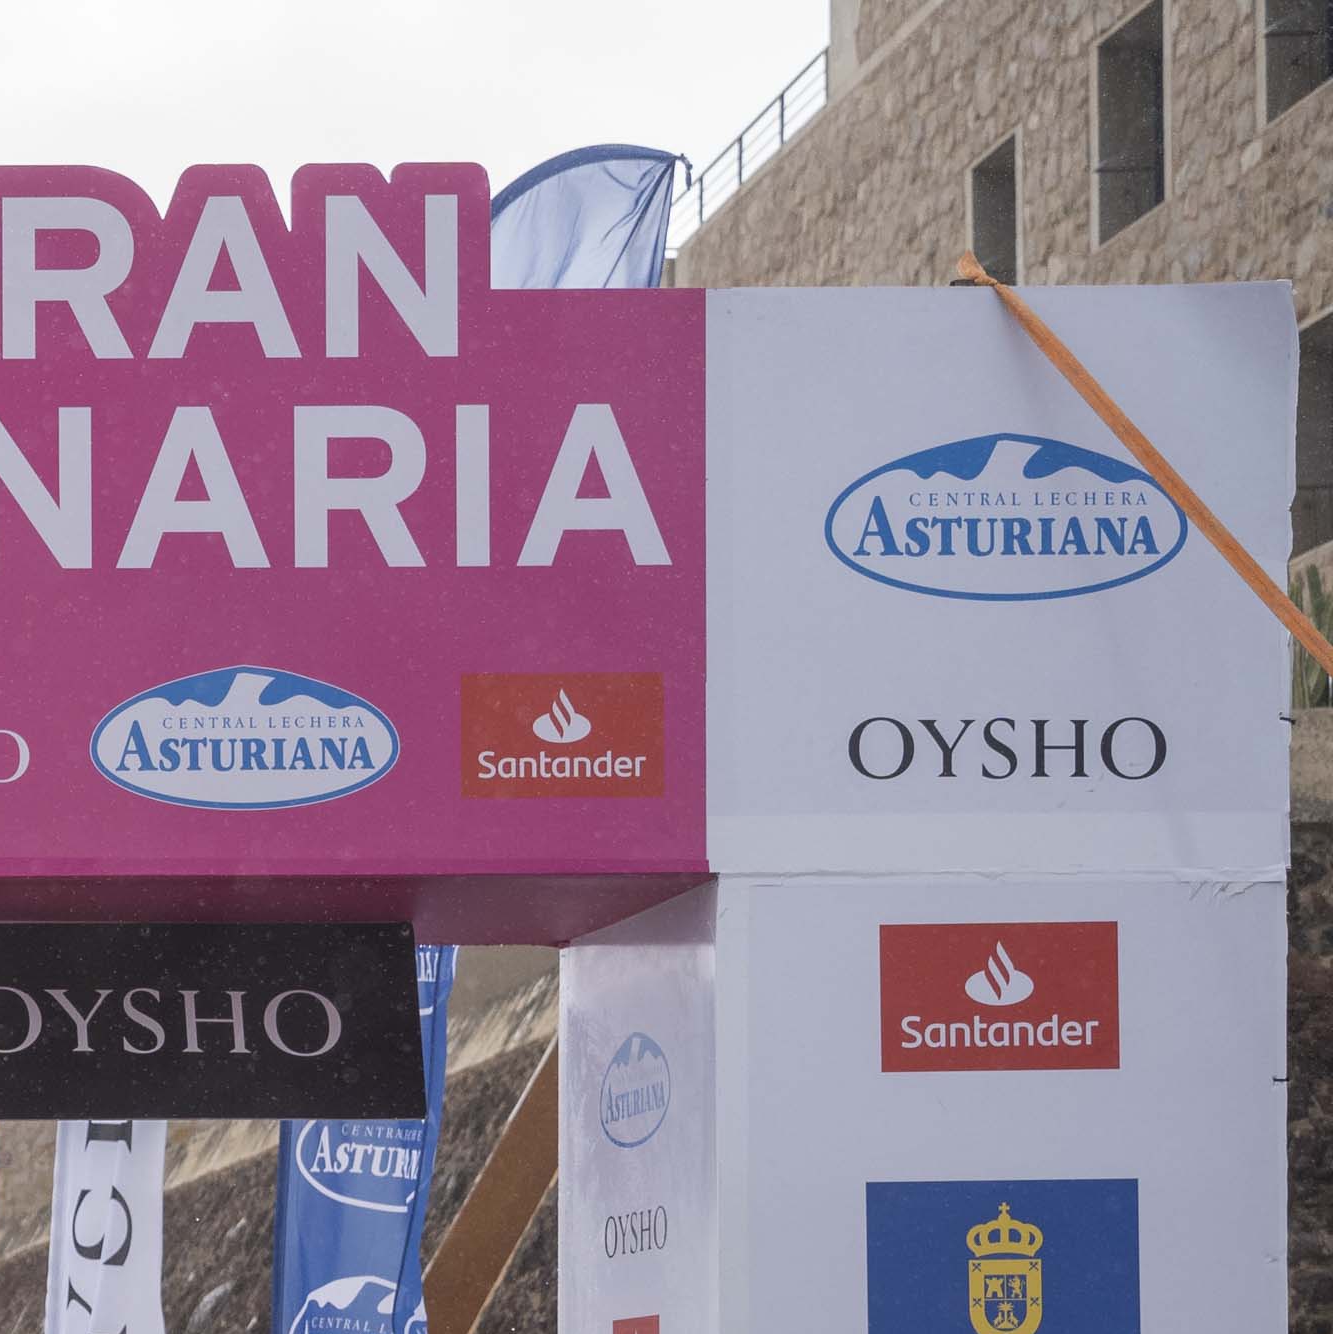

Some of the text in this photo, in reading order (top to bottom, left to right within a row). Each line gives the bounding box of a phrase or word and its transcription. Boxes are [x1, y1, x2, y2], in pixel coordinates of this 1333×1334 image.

[910, 492, 1146, 506] CENTRAL LECHERA
[853, 492, 1160, 557] ASTURIANA
[116, 717, 375, 771] ASTURIANA
[163, 716, 363, 729] CENTRAL LECHERA
[478, 751, 646, 778] Santander
[849, 717, 1166, 779] OYSHO
[901, 1014, 1098, 1048] Santander
[605, 1206, 667, 1258] OYSHO
